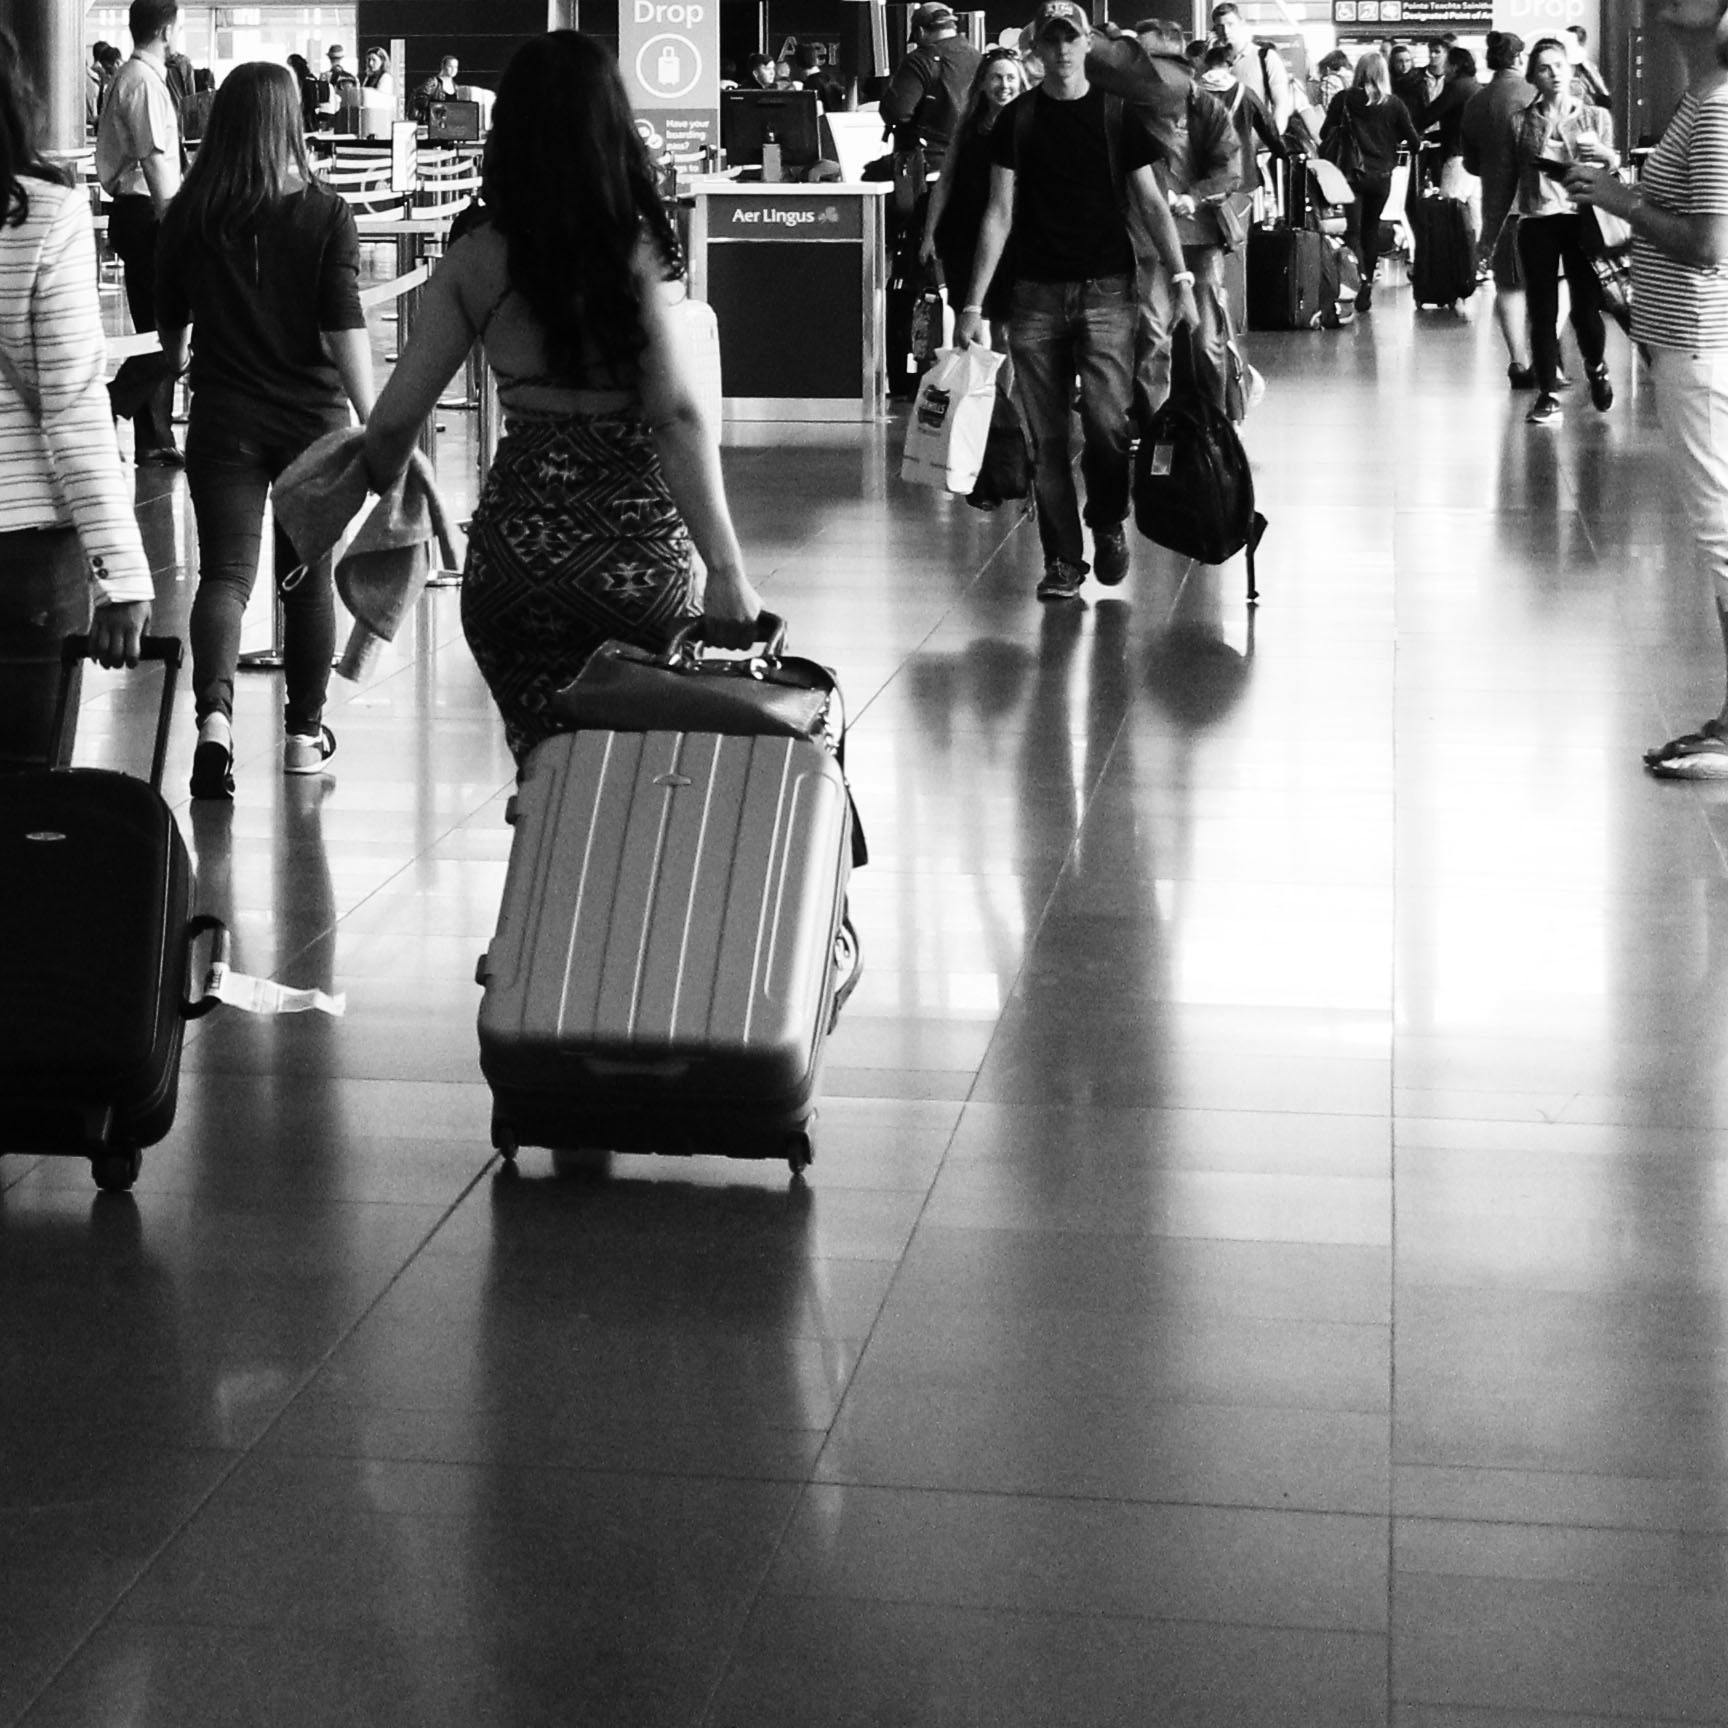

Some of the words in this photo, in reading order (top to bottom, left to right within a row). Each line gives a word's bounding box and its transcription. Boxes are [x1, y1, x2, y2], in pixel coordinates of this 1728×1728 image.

[633, 0, 705, 30] Drop
[732, 208, 761, 223] Aer
[763, 209, 815, 226] Lingus
